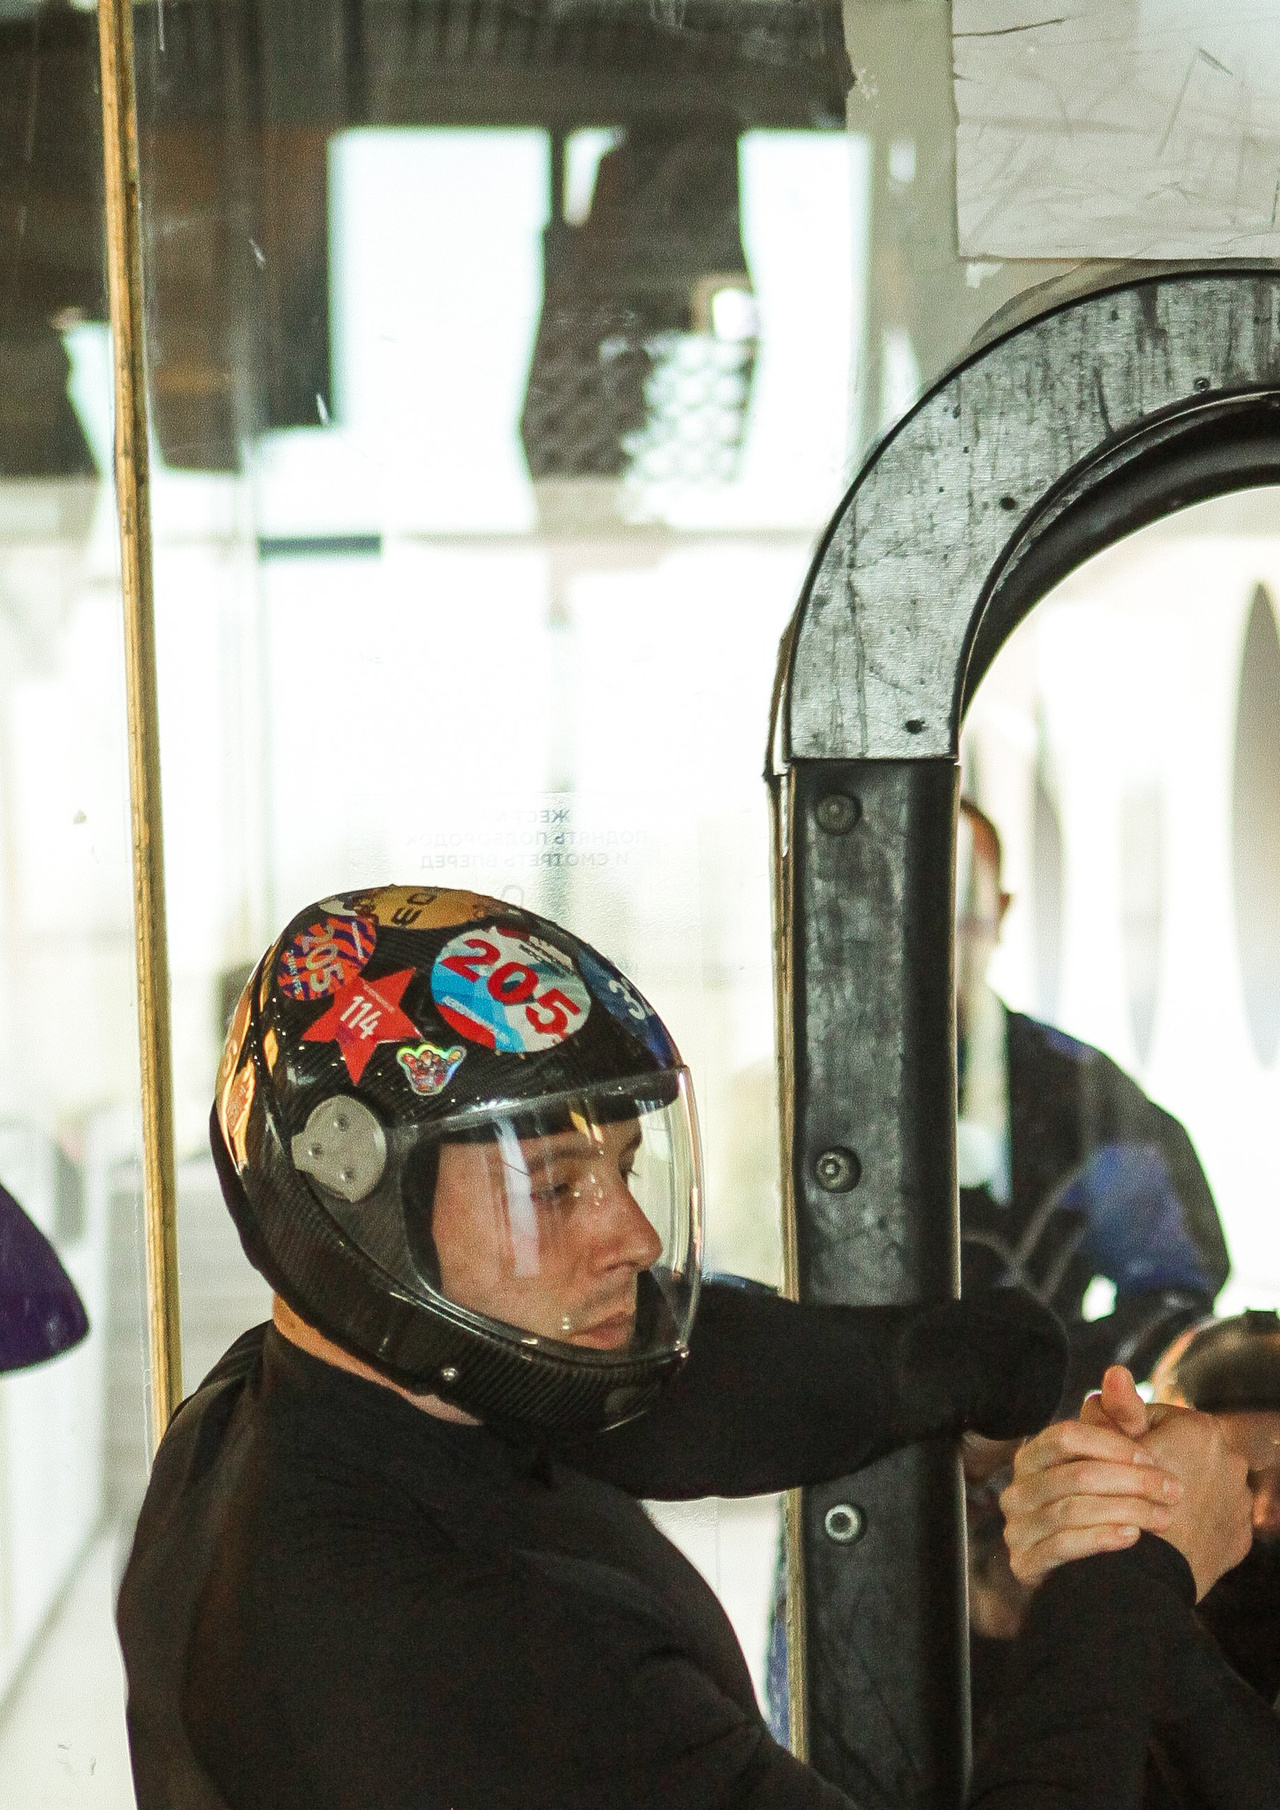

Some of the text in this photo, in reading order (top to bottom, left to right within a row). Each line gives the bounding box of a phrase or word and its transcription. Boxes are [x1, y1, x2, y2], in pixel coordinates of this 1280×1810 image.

[301, 924, 344, 992] 205
[439, 938, 582, 1034] 205
[340, 995, 382, 1040] 114
